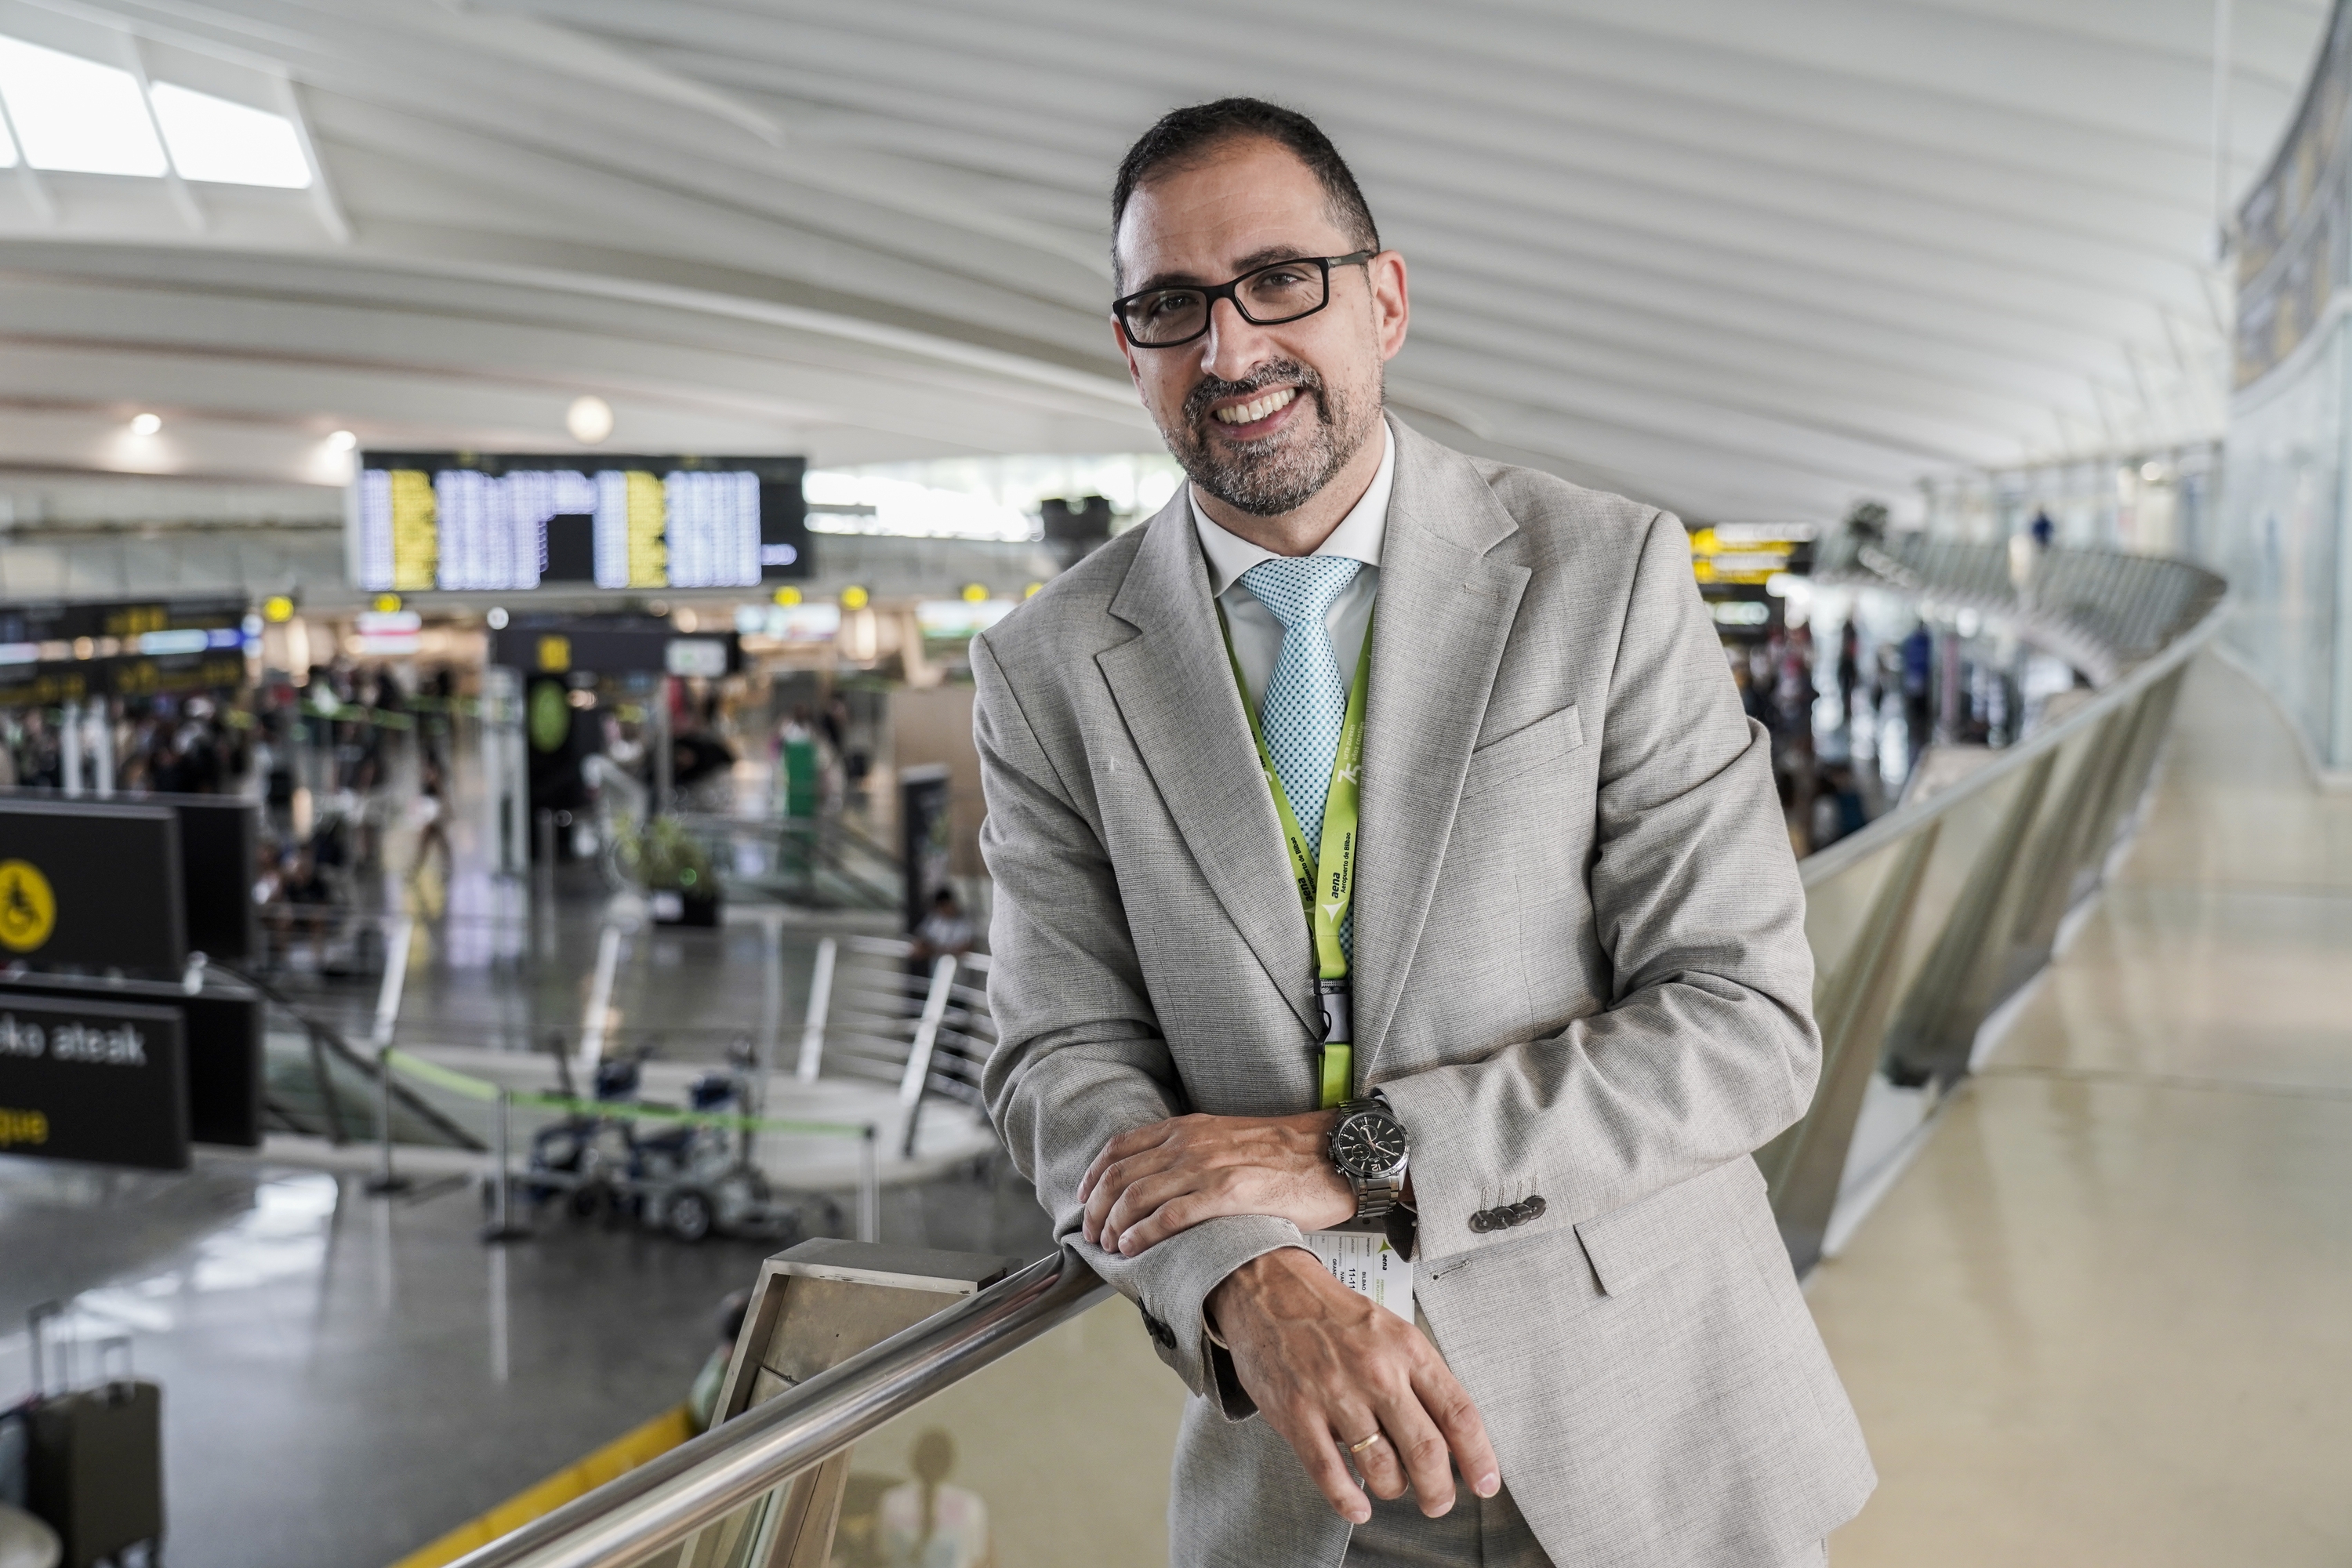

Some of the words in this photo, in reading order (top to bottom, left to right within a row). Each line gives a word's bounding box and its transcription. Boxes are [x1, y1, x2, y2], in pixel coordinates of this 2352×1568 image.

[1346, 724, 1356, 746] zurekin
[1337, 763, 1363, 786] 75
[1290, 837, 1301, 855] Bilbao
[1343, 851, 1349, 860] de
[1298, 854, 1305, 862] de
[1301, 862, 1317, 894] Aeropuerto
[1331, 872, 1341, 899] aena
[1340, 860, 1348, 894] Aeropuerto
[1298, 877, 1314, 902] aena
